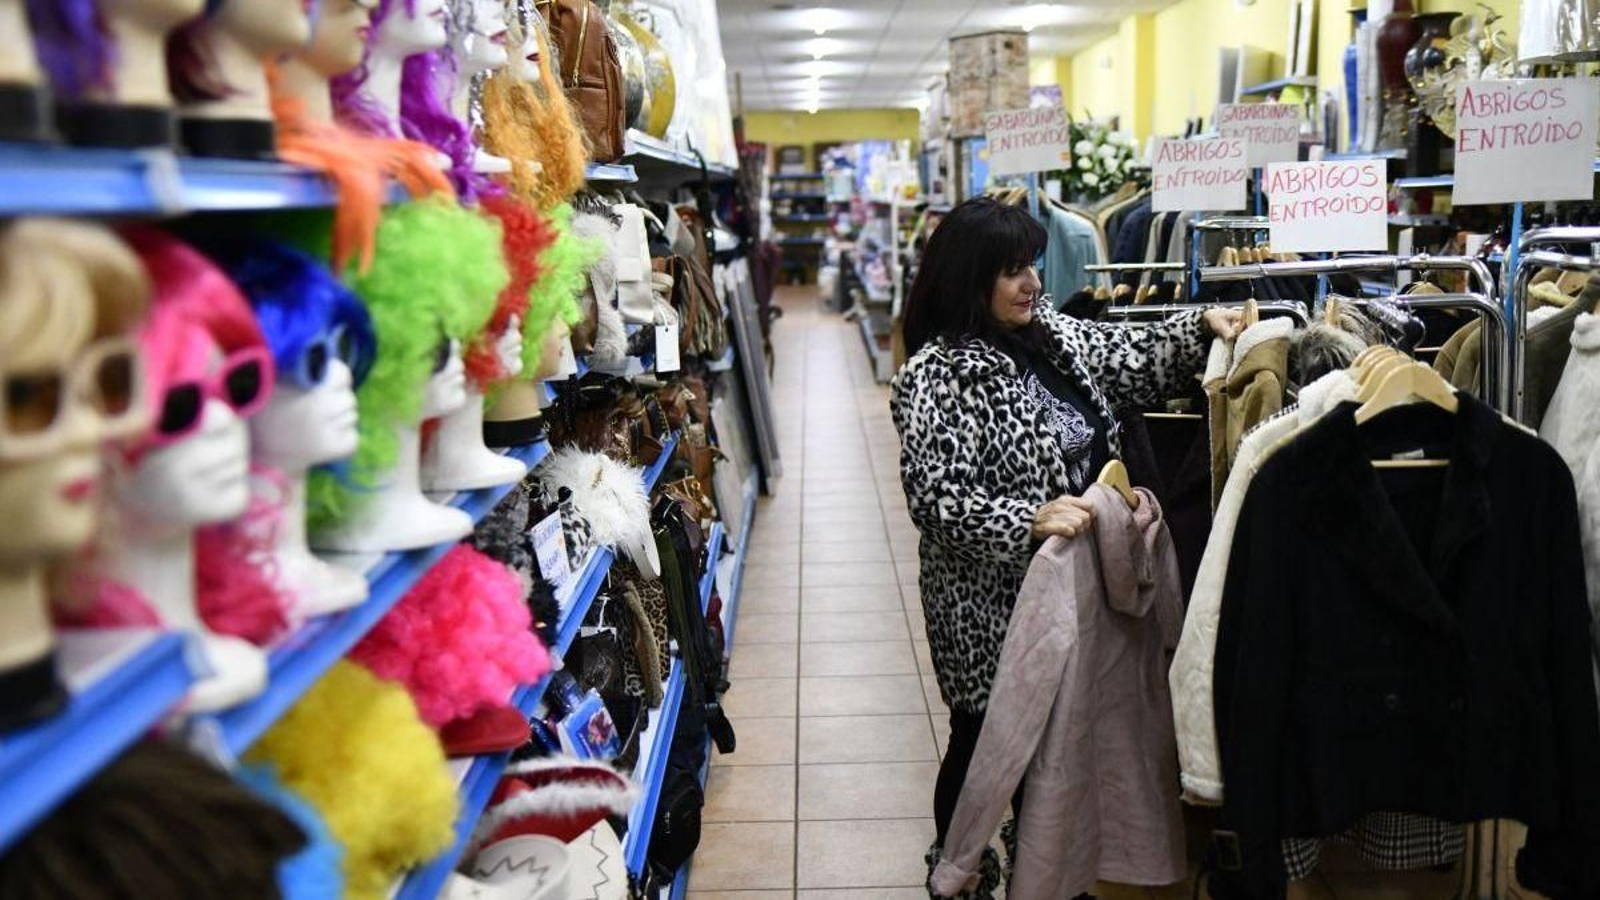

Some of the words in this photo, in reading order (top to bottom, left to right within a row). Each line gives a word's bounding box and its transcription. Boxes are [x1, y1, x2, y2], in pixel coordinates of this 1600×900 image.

[1221, 104, 1299, 123] GABARDINAS
[1460, 86, 1566, 118] ABRIGOS
[986, 106, 1066, 132] GABARDINAS
[989, 128, 1069, 154] ENTROIDO
[1458, 116, 1583, 153] ENTROIDO
[1157, 141, 1242, 163] ABRIGOS
[1153, 166, 1247, 192] ENTROIDO
[1271, 164, 1378, 193] ABRIGOS
[1270, 193, 1384, 222] ENTROIDO
